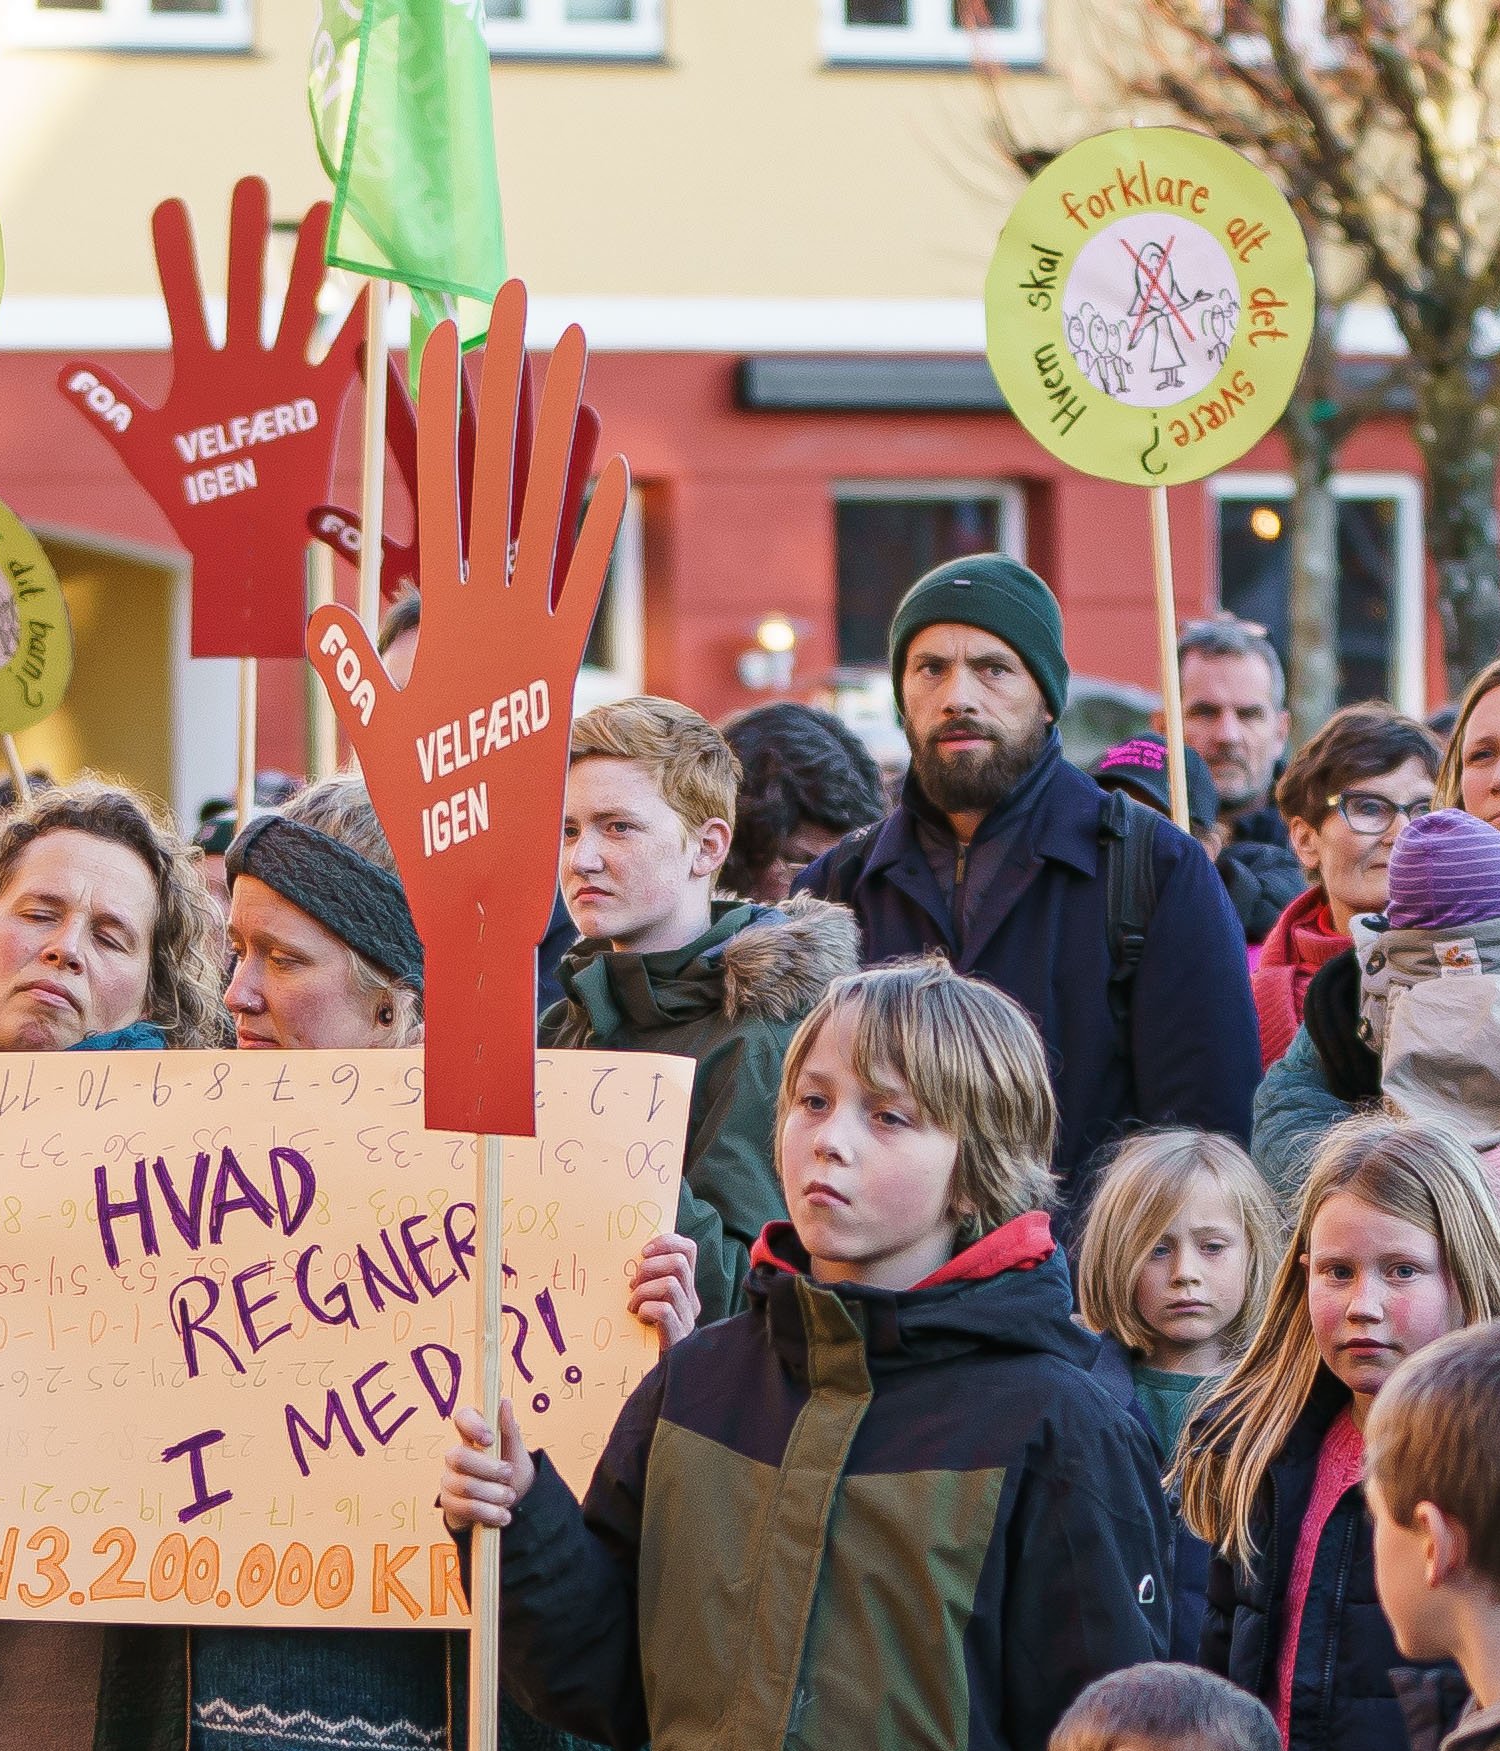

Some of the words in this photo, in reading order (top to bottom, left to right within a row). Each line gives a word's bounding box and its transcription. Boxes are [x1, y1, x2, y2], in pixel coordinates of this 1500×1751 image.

[1061, 160, 1209, 230] forklare
[1226, 218, 1271, 263] alt
[1019, 244, 1063, 311] skal
[1248, 287, 1288, 347] det
[68, 370, 133, 432] FOA
[1034, 343, 1087, 437] Hvem
[174, 398, 318, 464] VELFÆRD
[183, 458, 257, 505] IGEN
[319, 623, 377, 728] FOA
[415, 678, 551, 785] VELFÆRD
[420, 781, 490, 858] IGEN
[94, 1145, 316, 1269] HVAD
[167, 1201, 515, 1378] REGNER
[160, 1428, 234, 1525] I
[282, 1342, 464, 1479] MED
